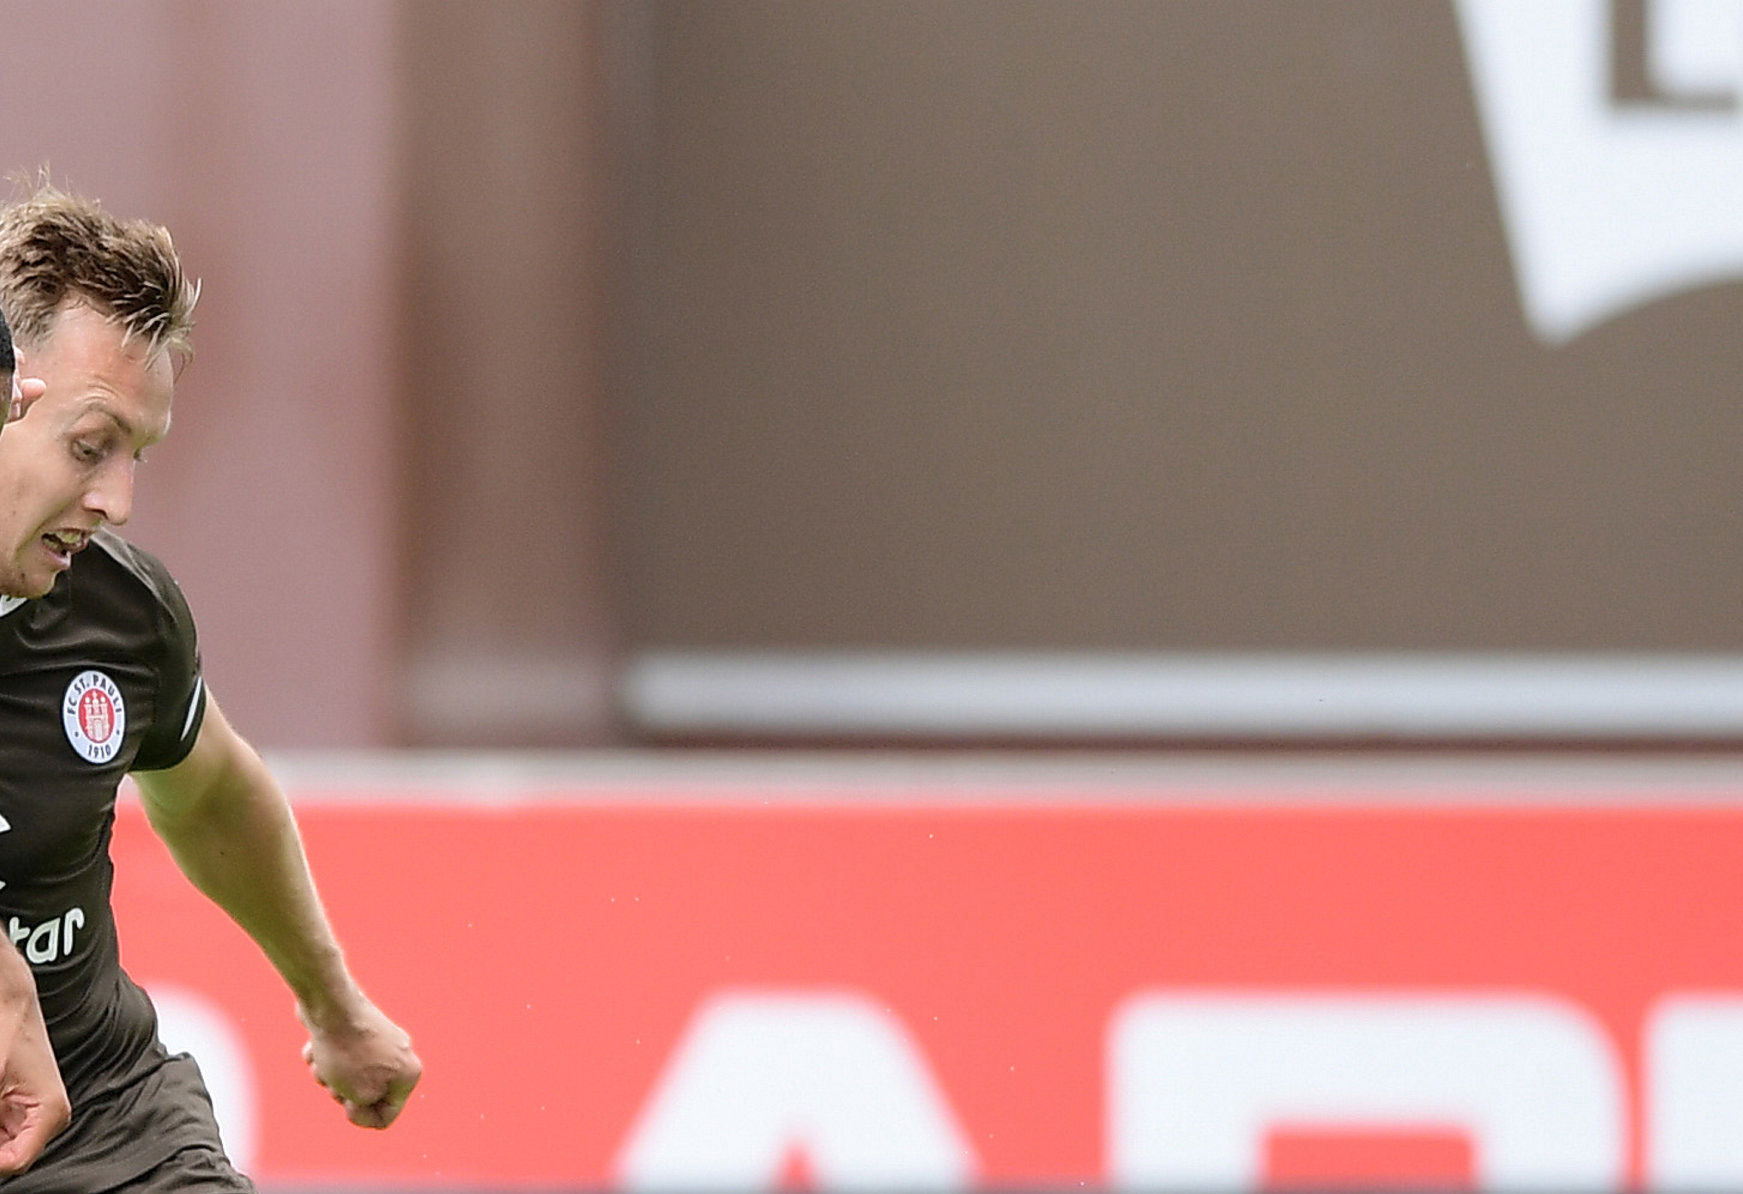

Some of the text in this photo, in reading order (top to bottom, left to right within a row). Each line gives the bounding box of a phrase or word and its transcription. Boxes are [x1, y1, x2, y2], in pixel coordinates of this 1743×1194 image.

[67, 674, 122, 715] FC ST. PAULI
[88, 744, 112, 759] 1910
